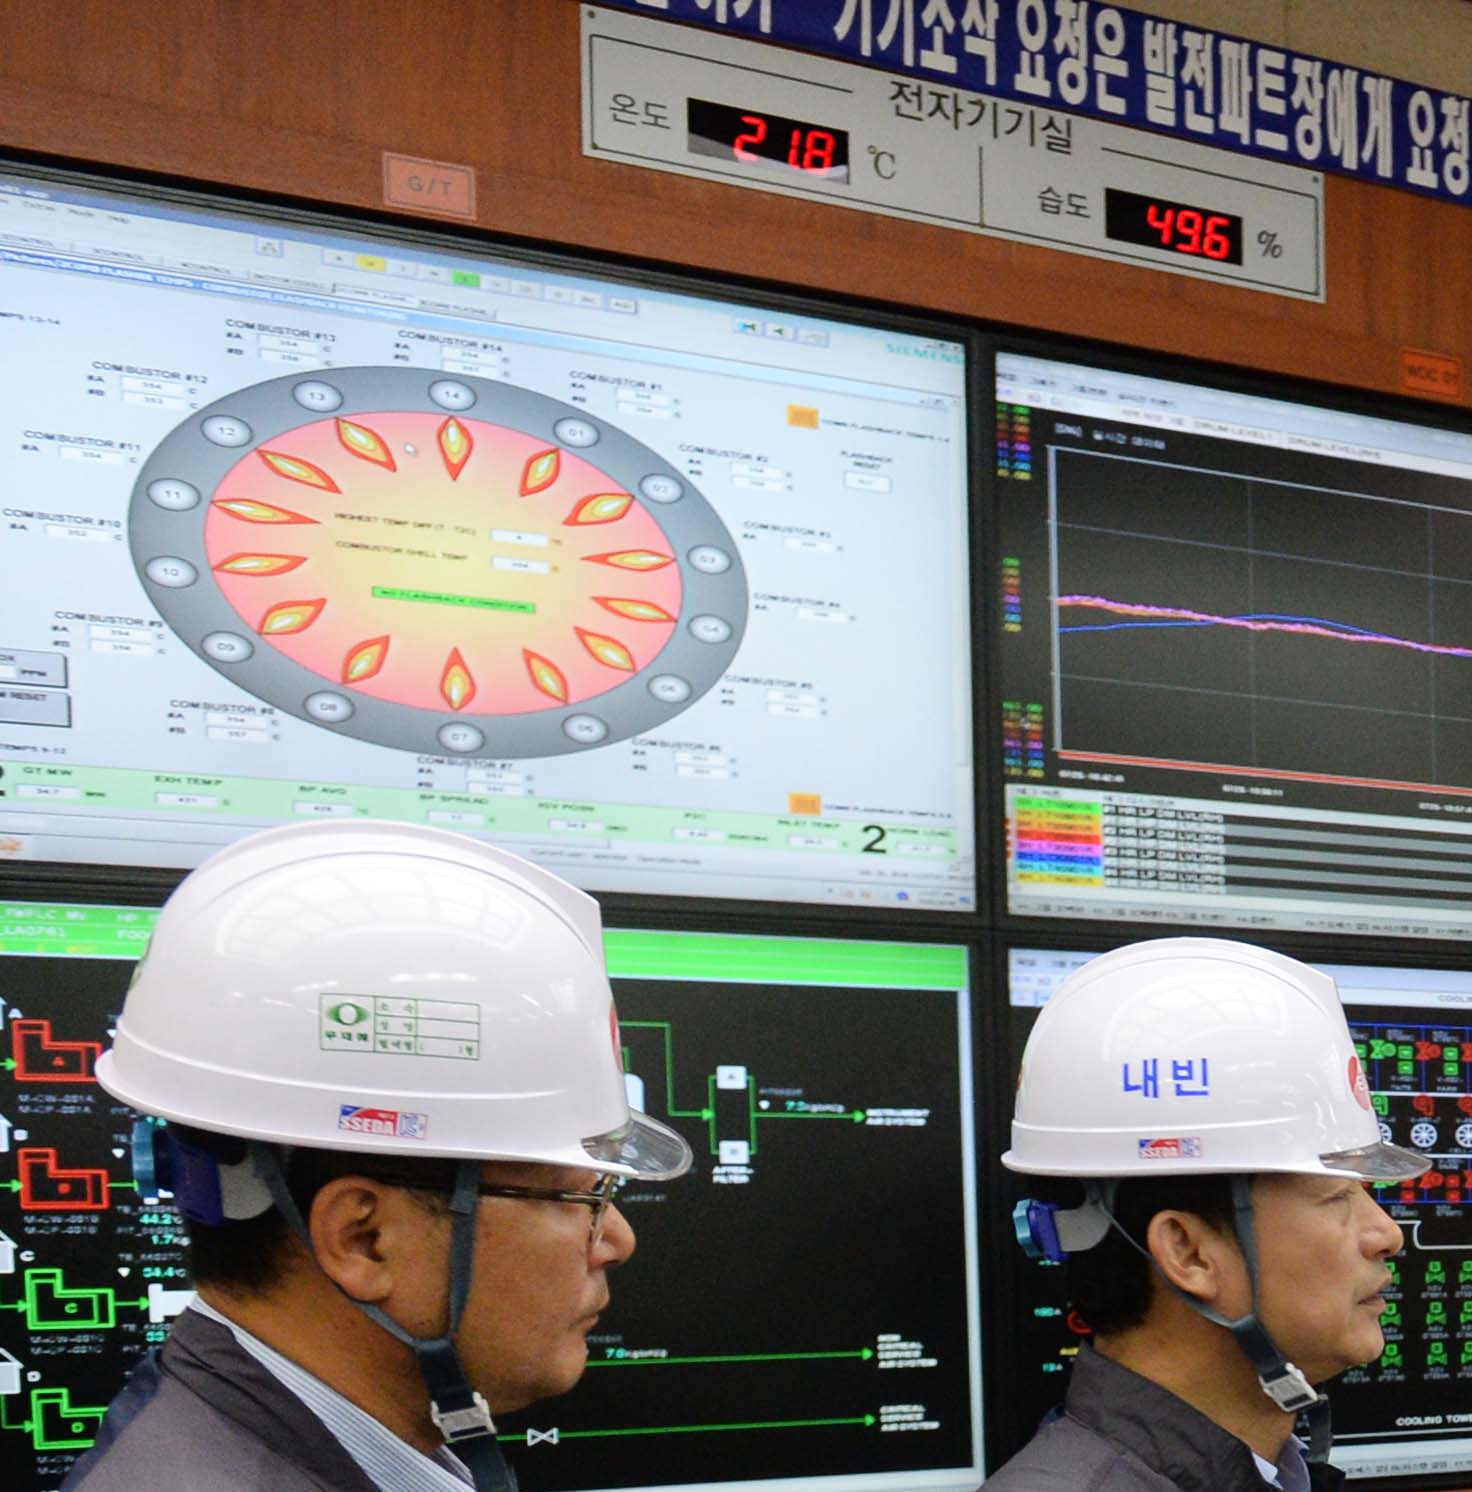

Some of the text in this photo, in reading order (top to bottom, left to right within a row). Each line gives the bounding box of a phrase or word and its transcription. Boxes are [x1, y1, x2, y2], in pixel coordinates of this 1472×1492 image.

[609, 94, 672, 130] 온도
[1014, 0, 1129, 116] 요청은
[1142, 18, 1394, 170] 발전파트장에게
[1406, 90, 1471, 197] 요청
[888, 79, 1074, 154] 전자기기실
[407, 175, 453, 197] G/T
[1037, 186, 1090, 220] 습도
[1256, 230, 1284, 260] %
[92, 360, 182, 381] COMBUSTOR
[24, 429, 114, 449] COMBUSTOR
[3, 508, 94, 527] COMBUSTOR
[862, 823, 888, 854] 2
[1123, 1057, 1209, 1099] 내빈
[1396, 1415, 1443, 1426] COOLING
